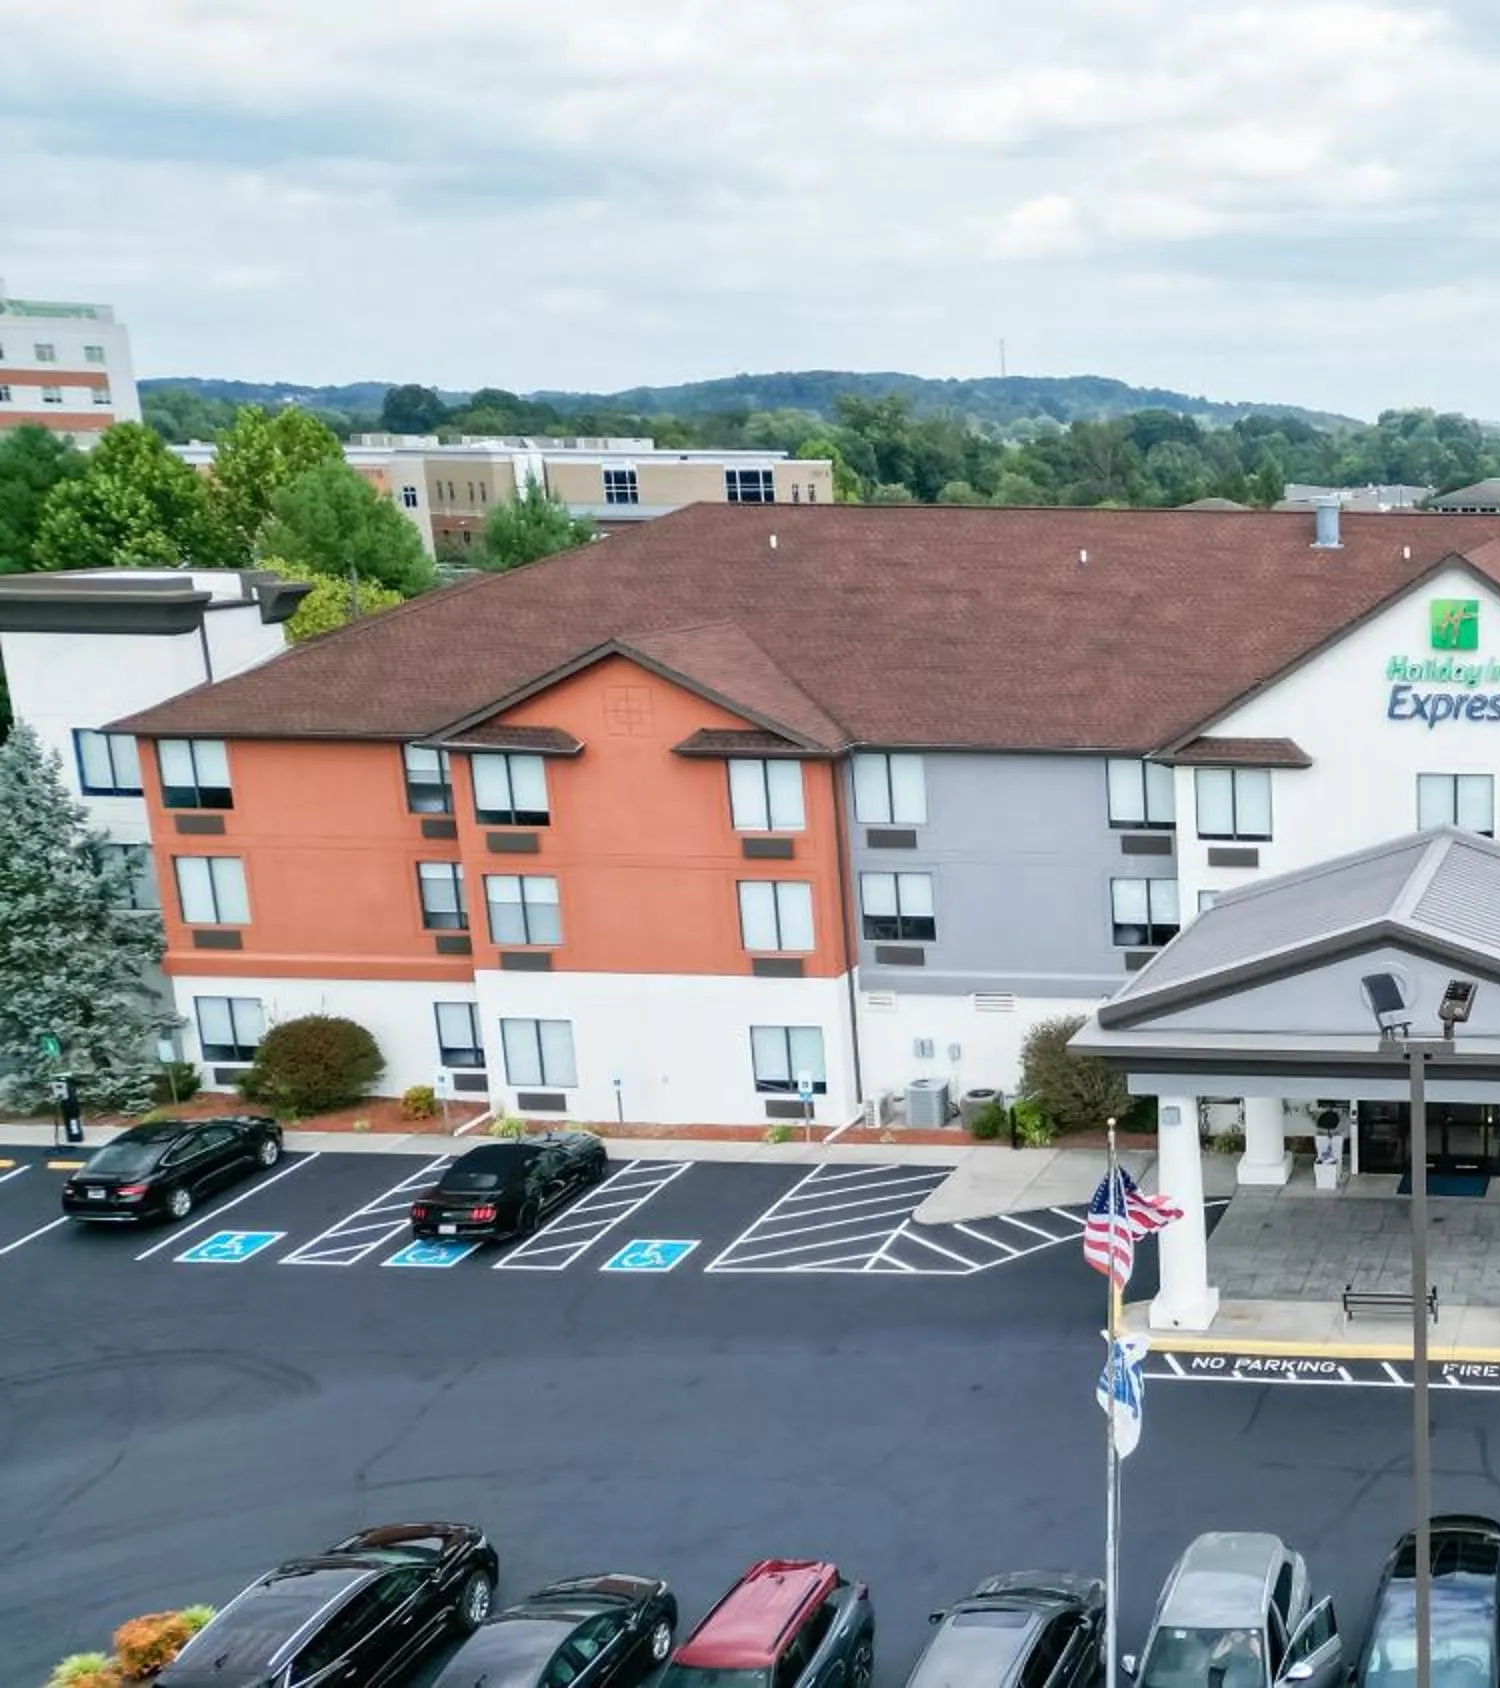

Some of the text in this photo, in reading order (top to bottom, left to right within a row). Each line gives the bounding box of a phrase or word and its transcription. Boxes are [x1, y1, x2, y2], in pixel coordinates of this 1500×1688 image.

[1387, 656, 1481, 688] Holiday
[1191, 1357, 1336, 1373] NO PARKING
[1441, 1363, 1499, 1377] FIRE
